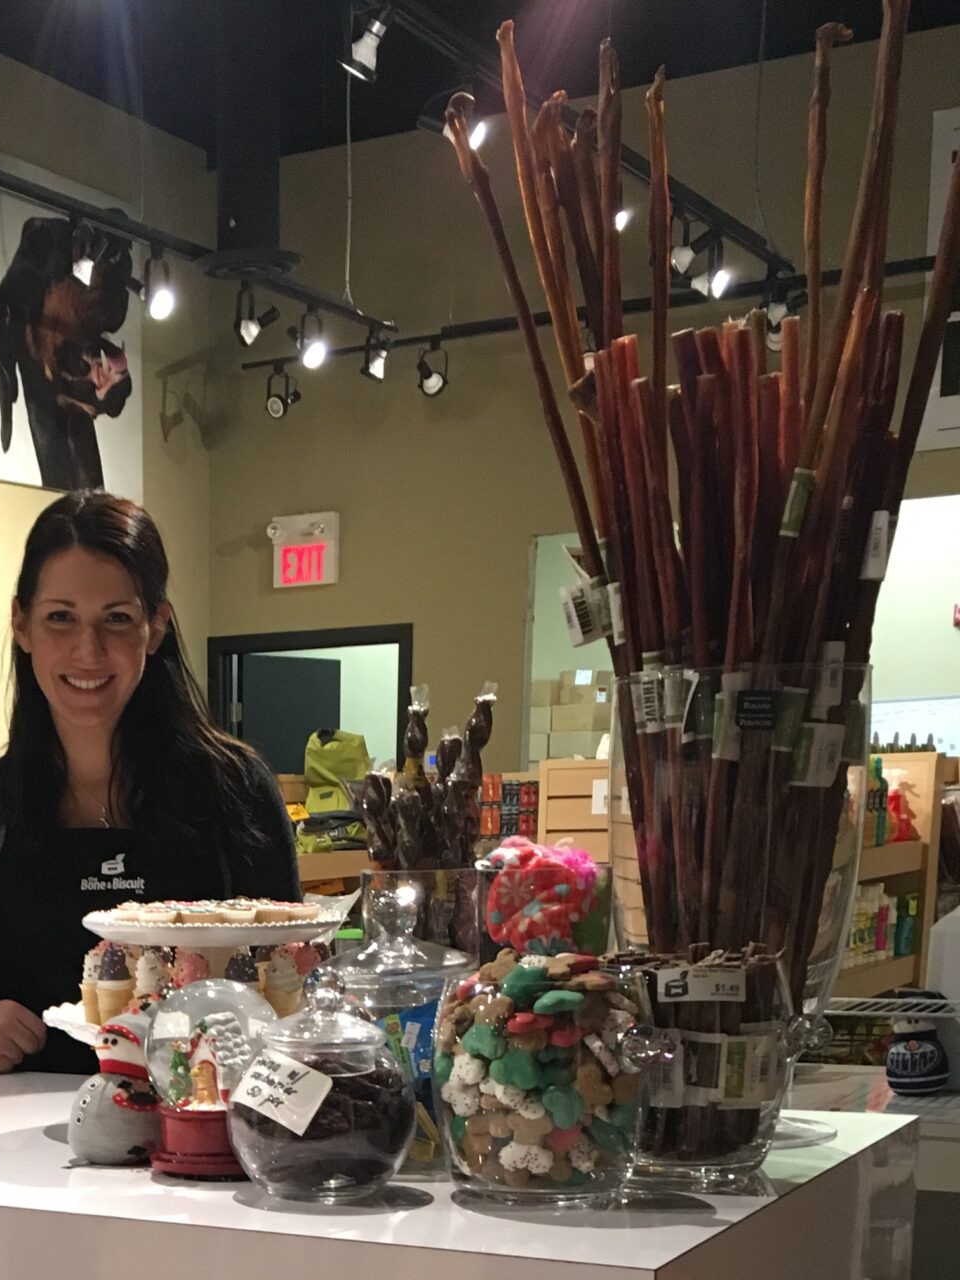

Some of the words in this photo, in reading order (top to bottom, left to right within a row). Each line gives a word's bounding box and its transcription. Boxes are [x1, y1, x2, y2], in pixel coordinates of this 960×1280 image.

[281, 542, 326, 585] EXIT
[642, 679, 659, 725] THRIVE
[80, 878, 107, 891] Bone
[112, 876, 145, 890] Biscuit
